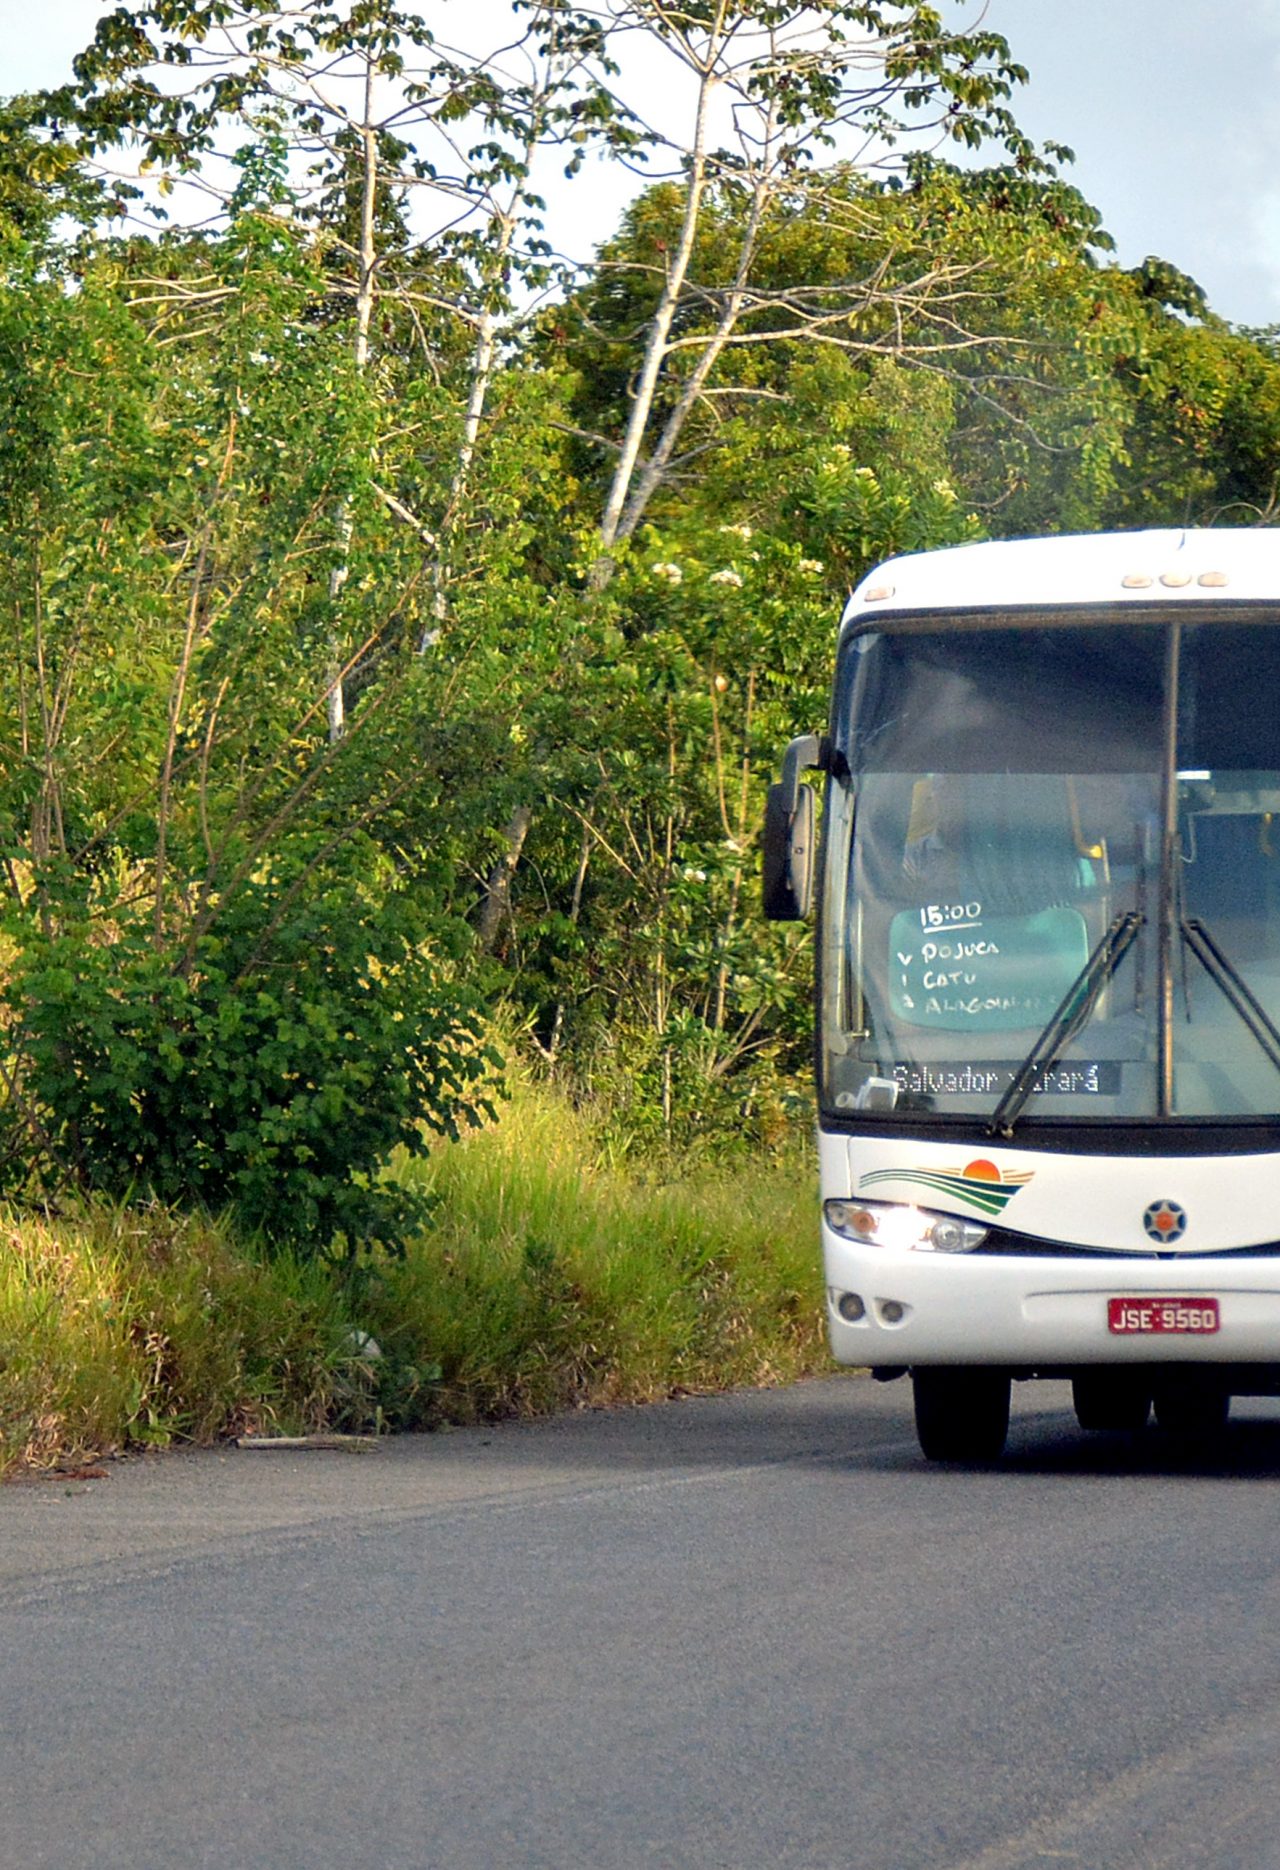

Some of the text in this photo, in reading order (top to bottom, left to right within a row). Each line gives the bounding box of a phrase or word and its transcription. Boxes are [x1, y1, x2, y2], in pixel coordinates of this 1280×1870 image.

[920, 901, 982, 927] 15:00
[921, 941, 1000, 964] POJUCA
[923, 971, 977, 989] CATU
[893, 1065, 999, 1092] Salvador
